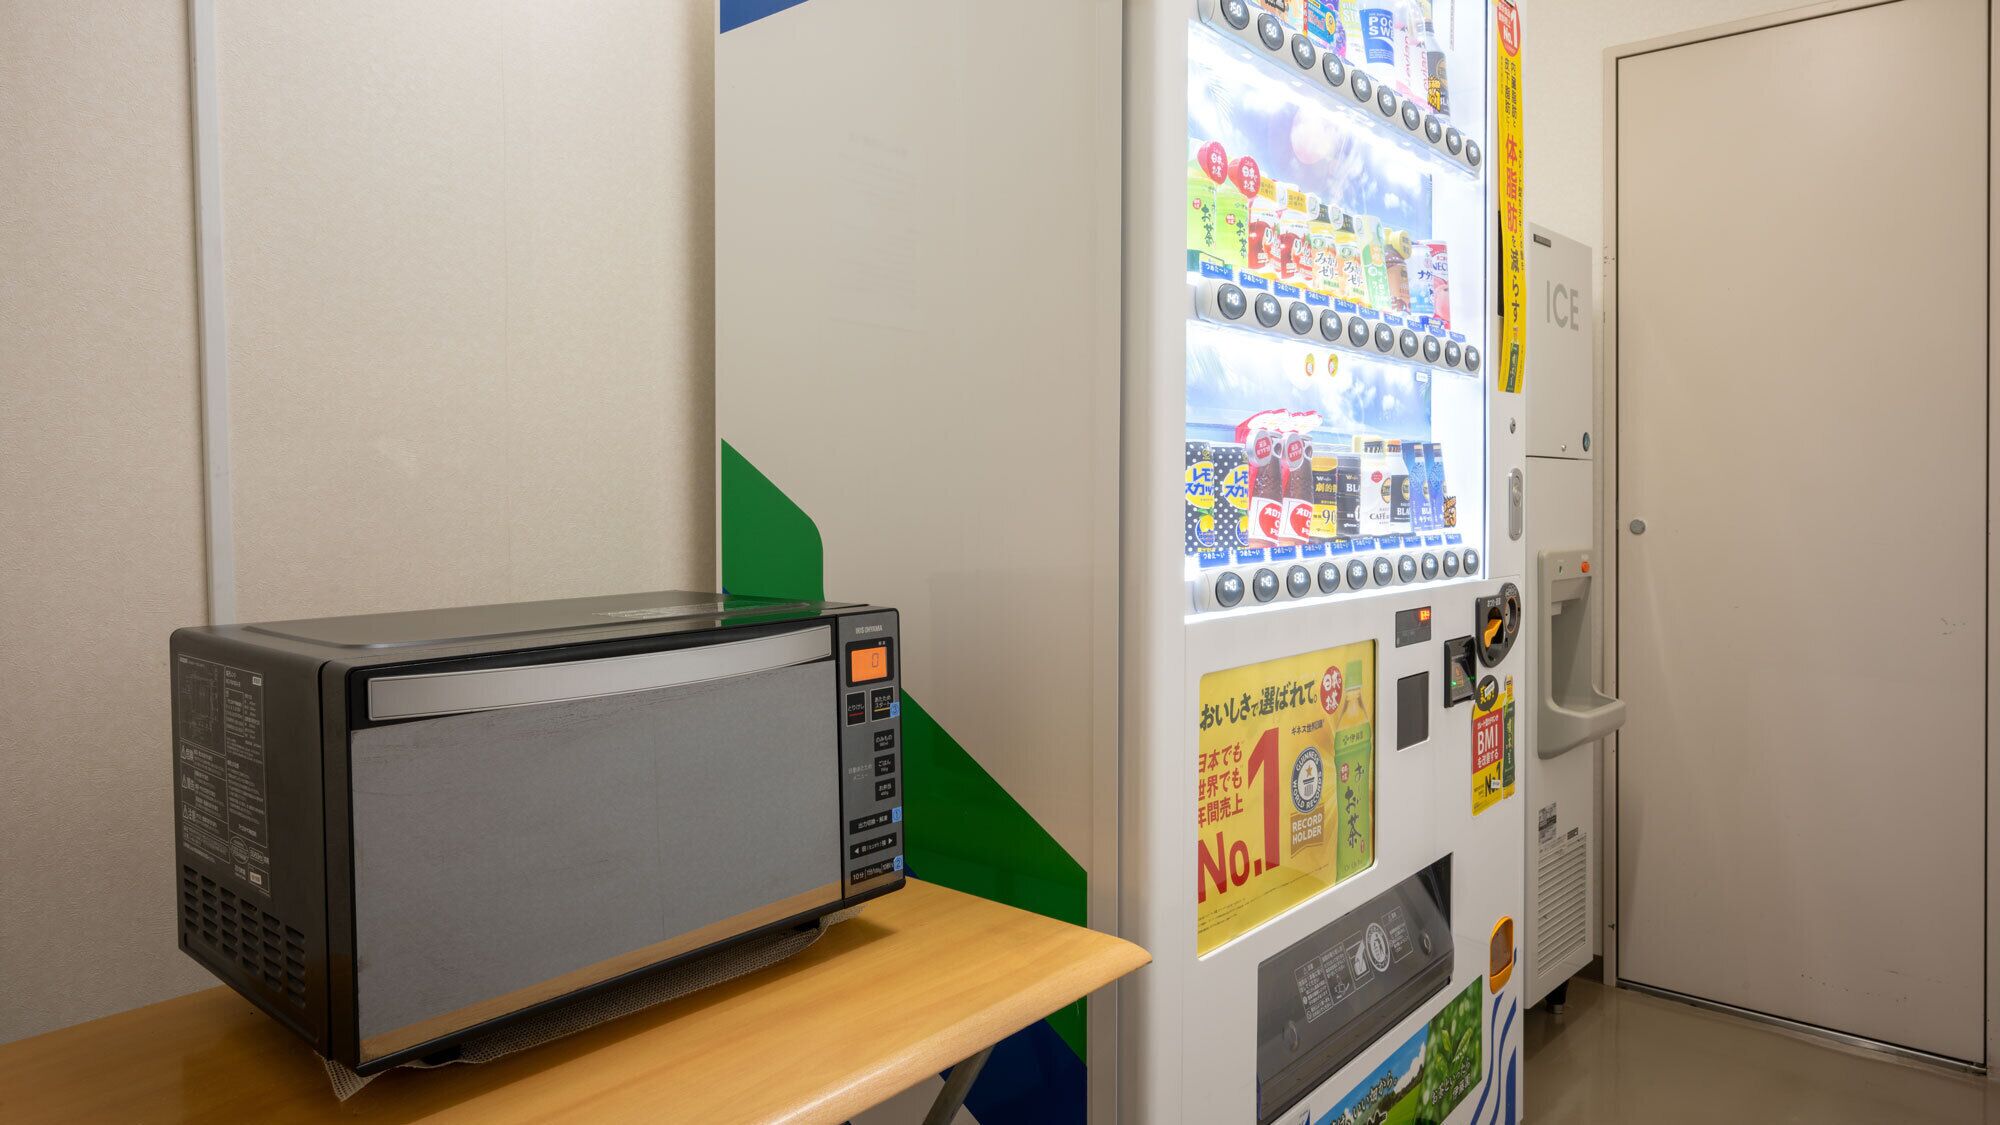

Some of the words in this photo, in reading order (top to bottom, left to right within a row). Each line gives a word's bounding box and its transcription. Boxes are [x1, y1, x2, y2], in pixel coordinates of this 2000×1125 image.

[1546, 280, 1579, 332] ICE
[1200, 681, 1318, 731] おいしさで選ばれて。
[1478, 724, 1498, 756] BMI
[1295, 749, 1321, 772] GUINNESS
[1293, 780, 1305, 811] WORLD
[1292, 813, 1322, 833] RECORD
[1292, 827, 1322, 845] HOLDER
